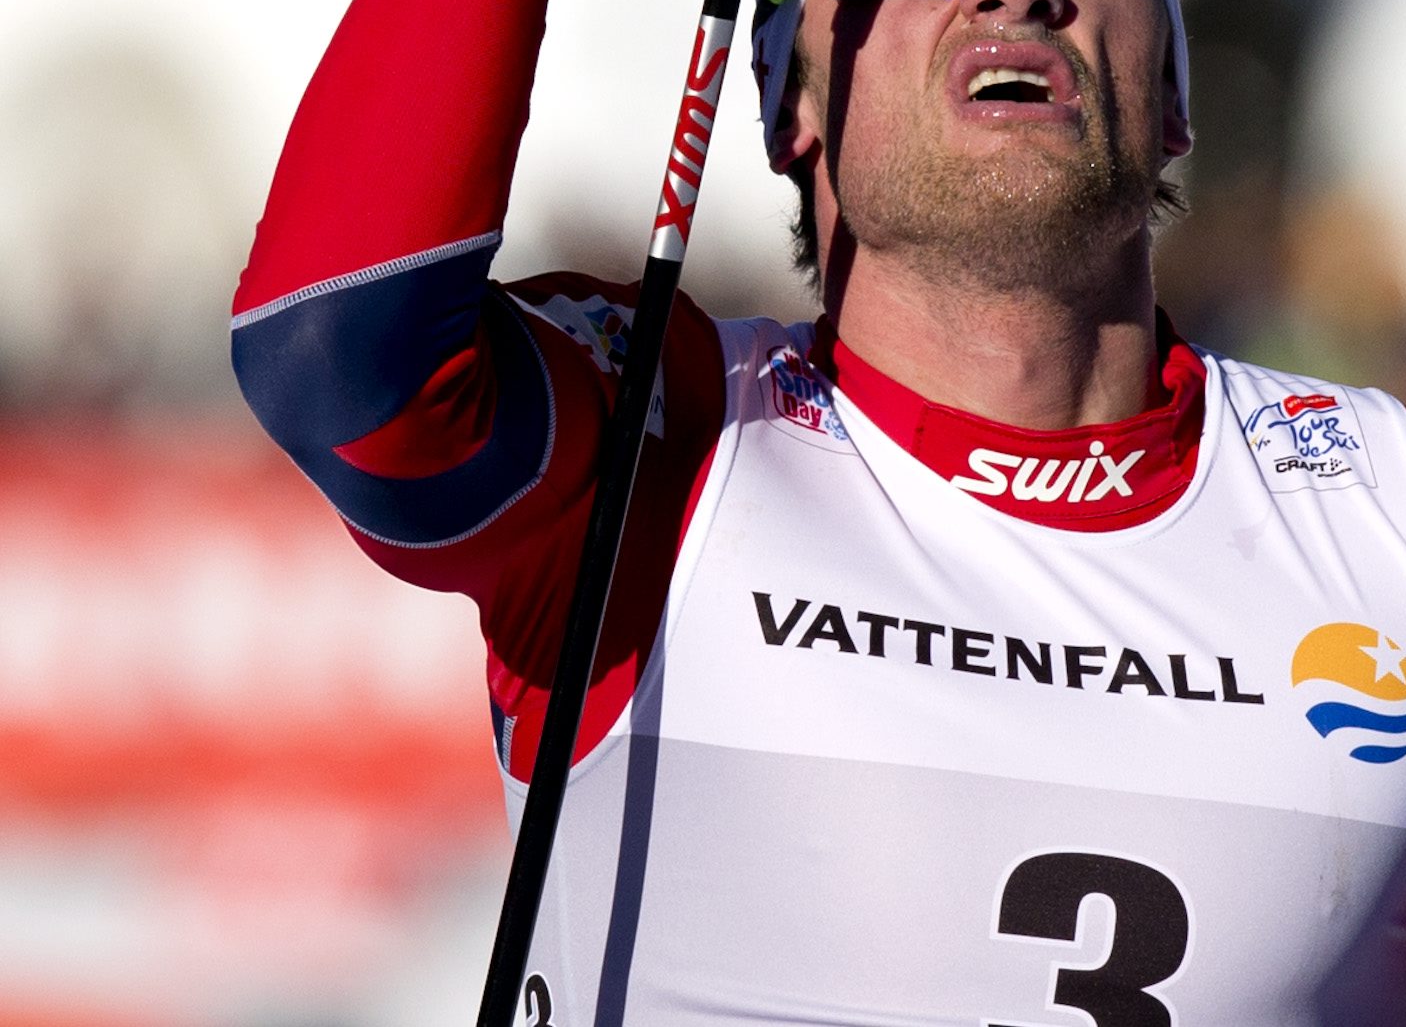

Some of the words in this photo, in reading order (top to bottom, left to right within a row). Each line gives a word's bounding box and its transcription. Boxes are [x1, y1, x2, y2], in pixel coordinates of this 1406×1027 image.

[771, 358, 834, 409] Sno
[781, 392, 823, 430] Day
[1275, 459, 1327, 473] CRAFT
[751, 590, 1266, 706] VATTENFALL
[987, 851, 1190, 1027] 3
